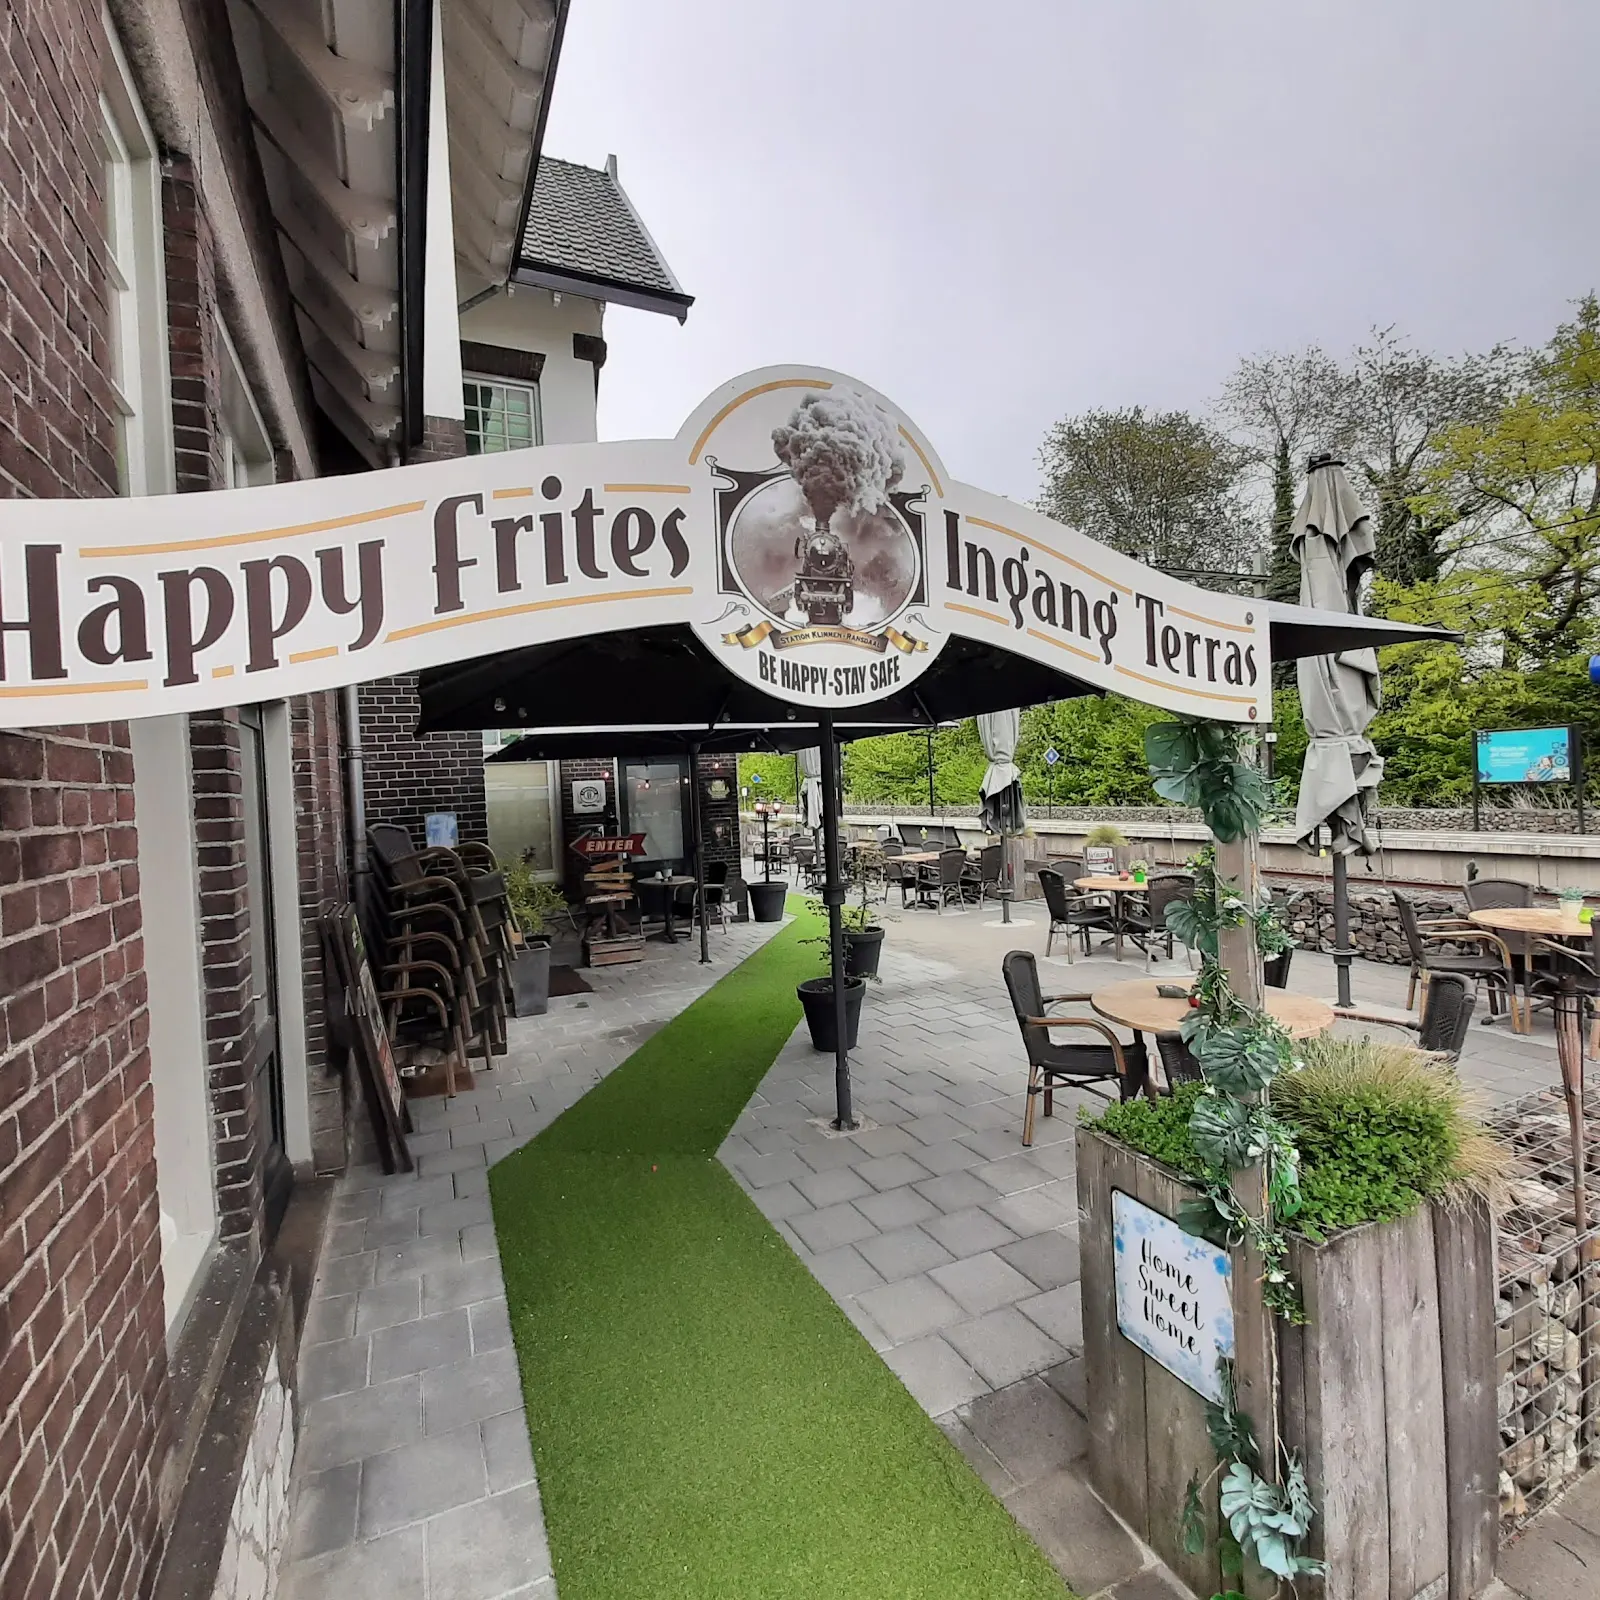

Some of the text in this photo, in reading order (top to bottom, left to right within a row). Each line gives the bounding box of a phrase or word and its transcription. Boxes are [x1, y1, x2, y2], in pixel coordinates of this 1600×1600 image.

[0, 475, 691, 688] Happy frites
[943, 509, 1257, 687] Ingang Terras
[758, 650, 778, 685] BE
[870, 655, 900, 691] SAFE
[585, 839, 634, 852] ENTER
[1141, 1237, 1199, 1295] Home
[1138, 1264, 1204, 1330] Sweet
[1143, 1295, 1201, 1356] Home
